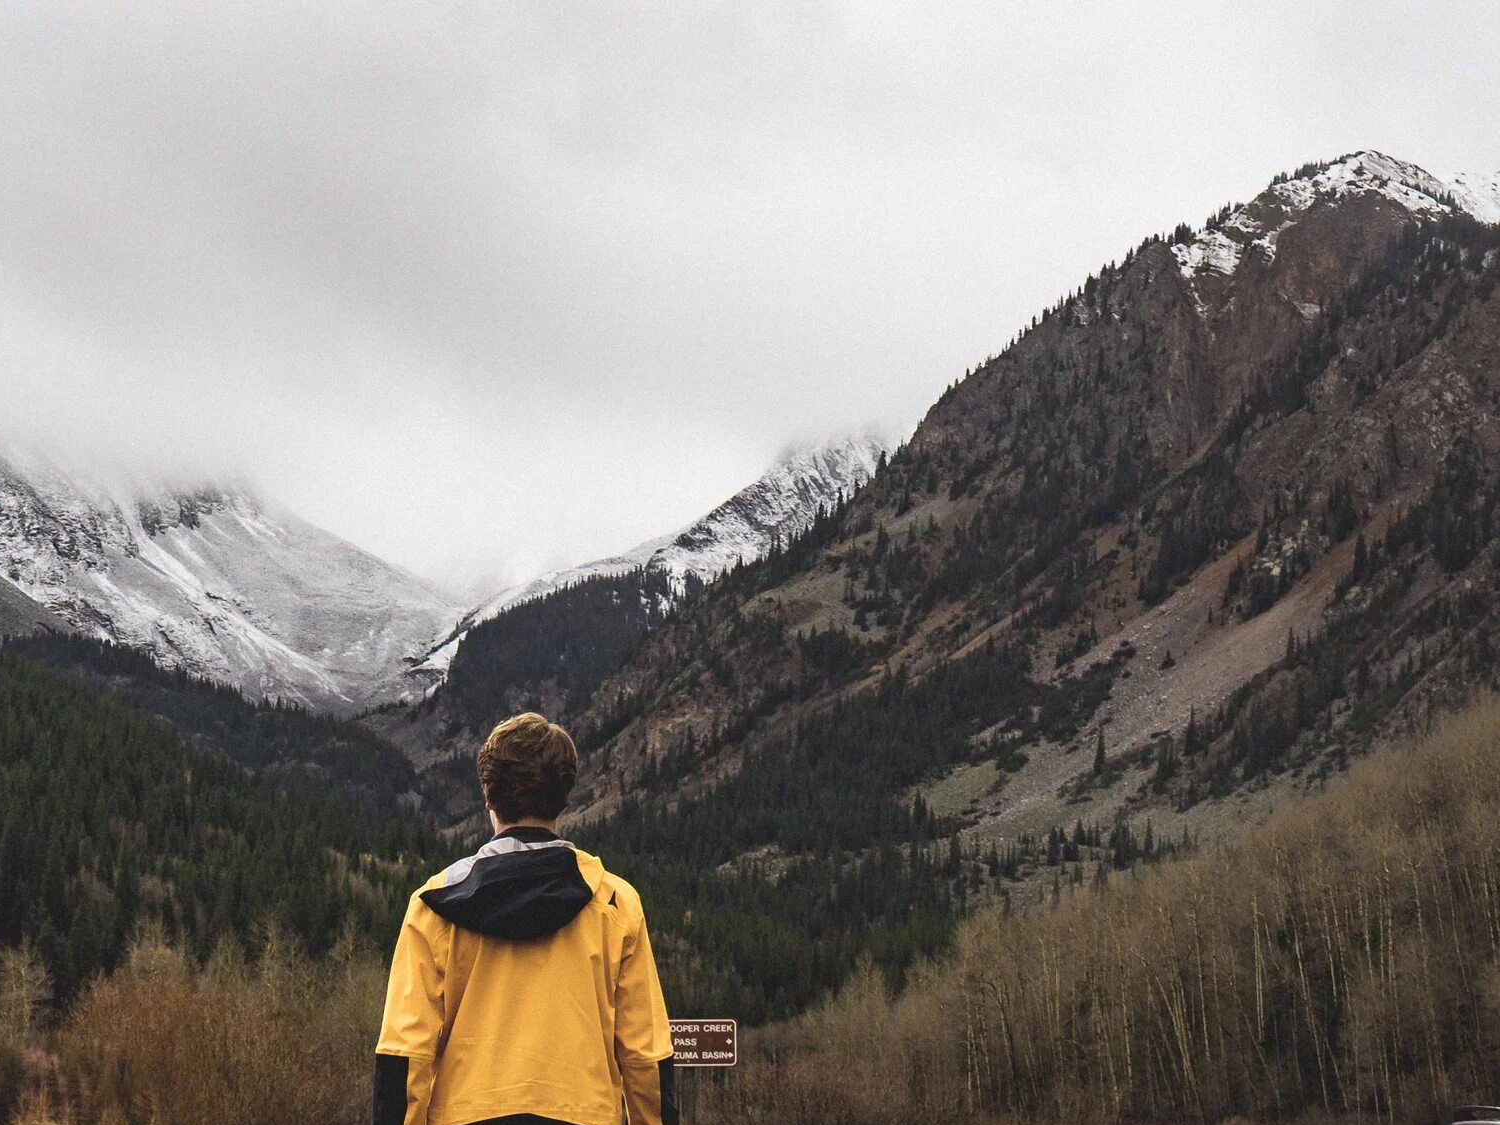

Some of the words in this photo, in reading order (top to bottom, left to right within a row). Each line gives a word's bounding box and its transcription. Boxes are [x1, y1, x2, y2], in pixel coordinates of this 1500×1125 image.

[703, 1024, 733, 1032] CREEK
[674, 1038, 697, 1046] PASS
[702, 1051, 728, 1059] BASIN
